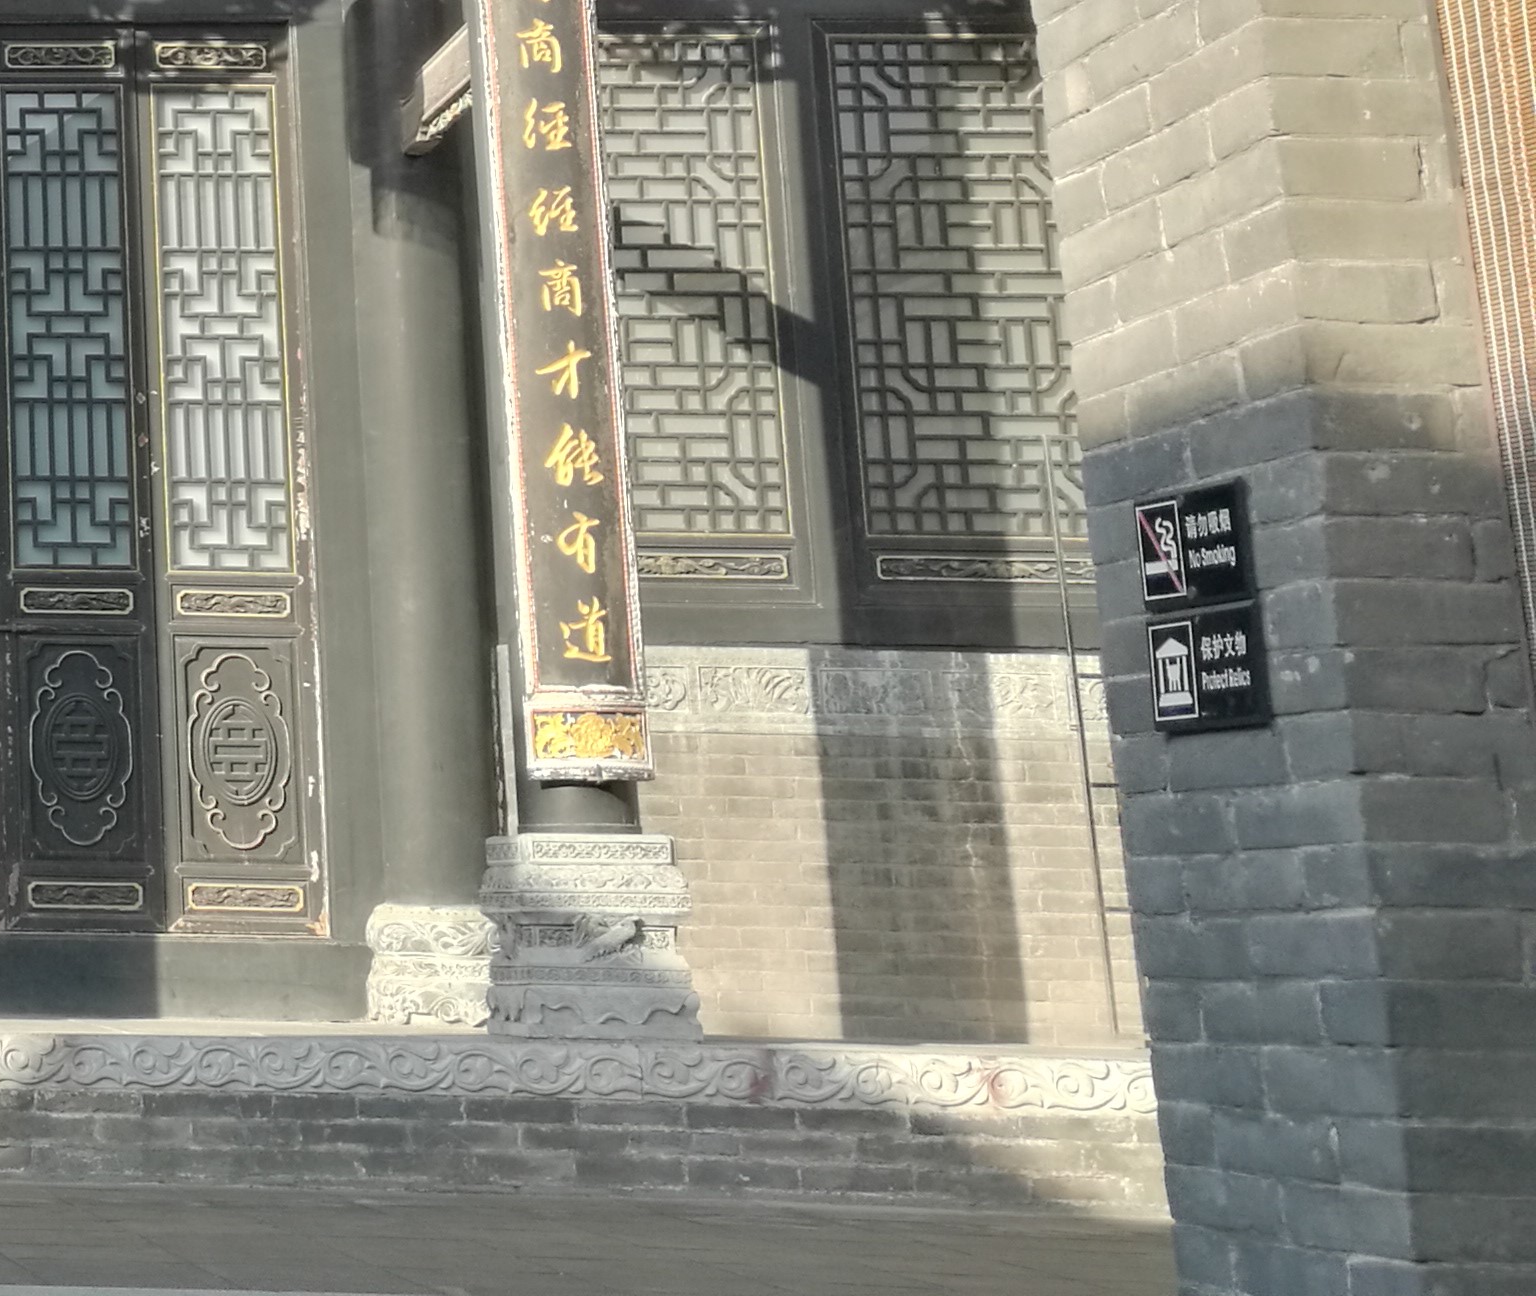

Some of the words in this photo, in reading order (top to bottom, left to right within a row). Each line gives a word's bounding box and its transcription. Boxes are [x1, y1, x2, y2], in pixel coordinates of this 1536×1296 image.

[1184, 507, 1232, 539] 请勿吸烟
[1188, 549, 1201, 569] No
[1201, 544, 1237, 567] Smoking
[1200, 630, 1247, 661] 保护文物
